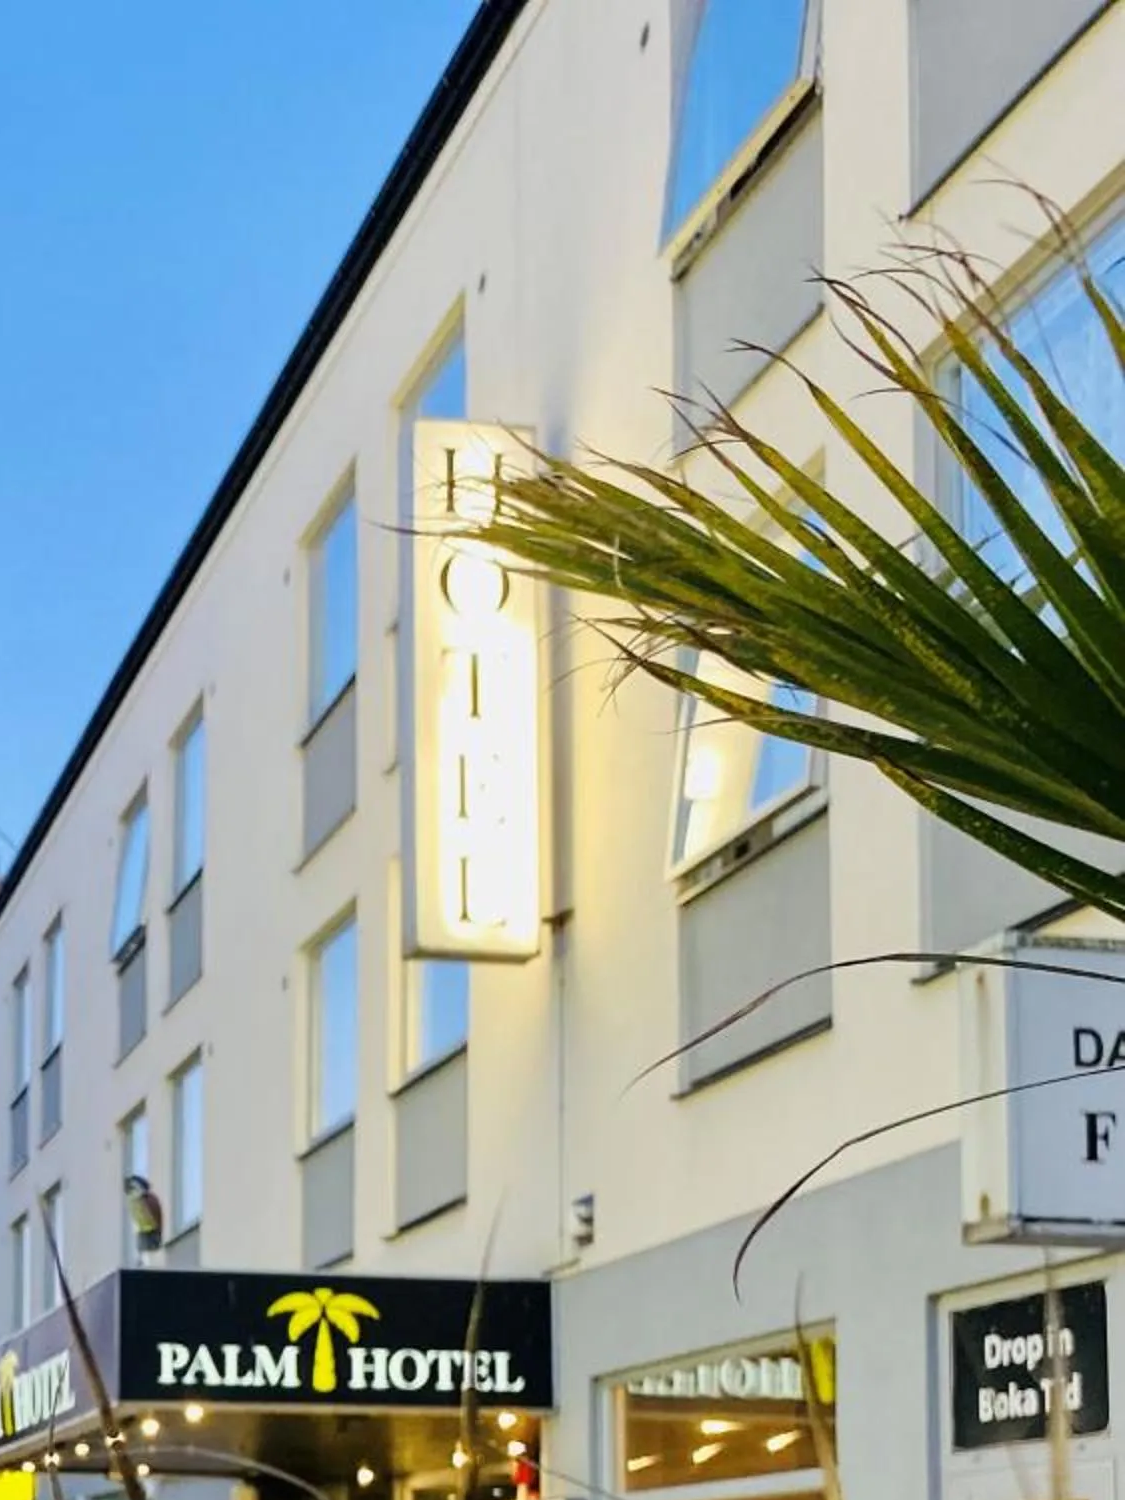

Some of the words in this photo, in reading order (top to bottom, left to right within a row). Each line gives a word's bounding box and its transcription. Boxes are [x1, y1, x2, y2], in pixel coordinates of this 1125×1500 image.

[157, 1341, 302, 1388] PALM
[347, 1347, 526, 1393] HOTEL
[984, 1333, 1044, 1372] Drop
[978, 1381, 1040, 1424] Boka
[1040, 1371, 1083, 1413] Td
